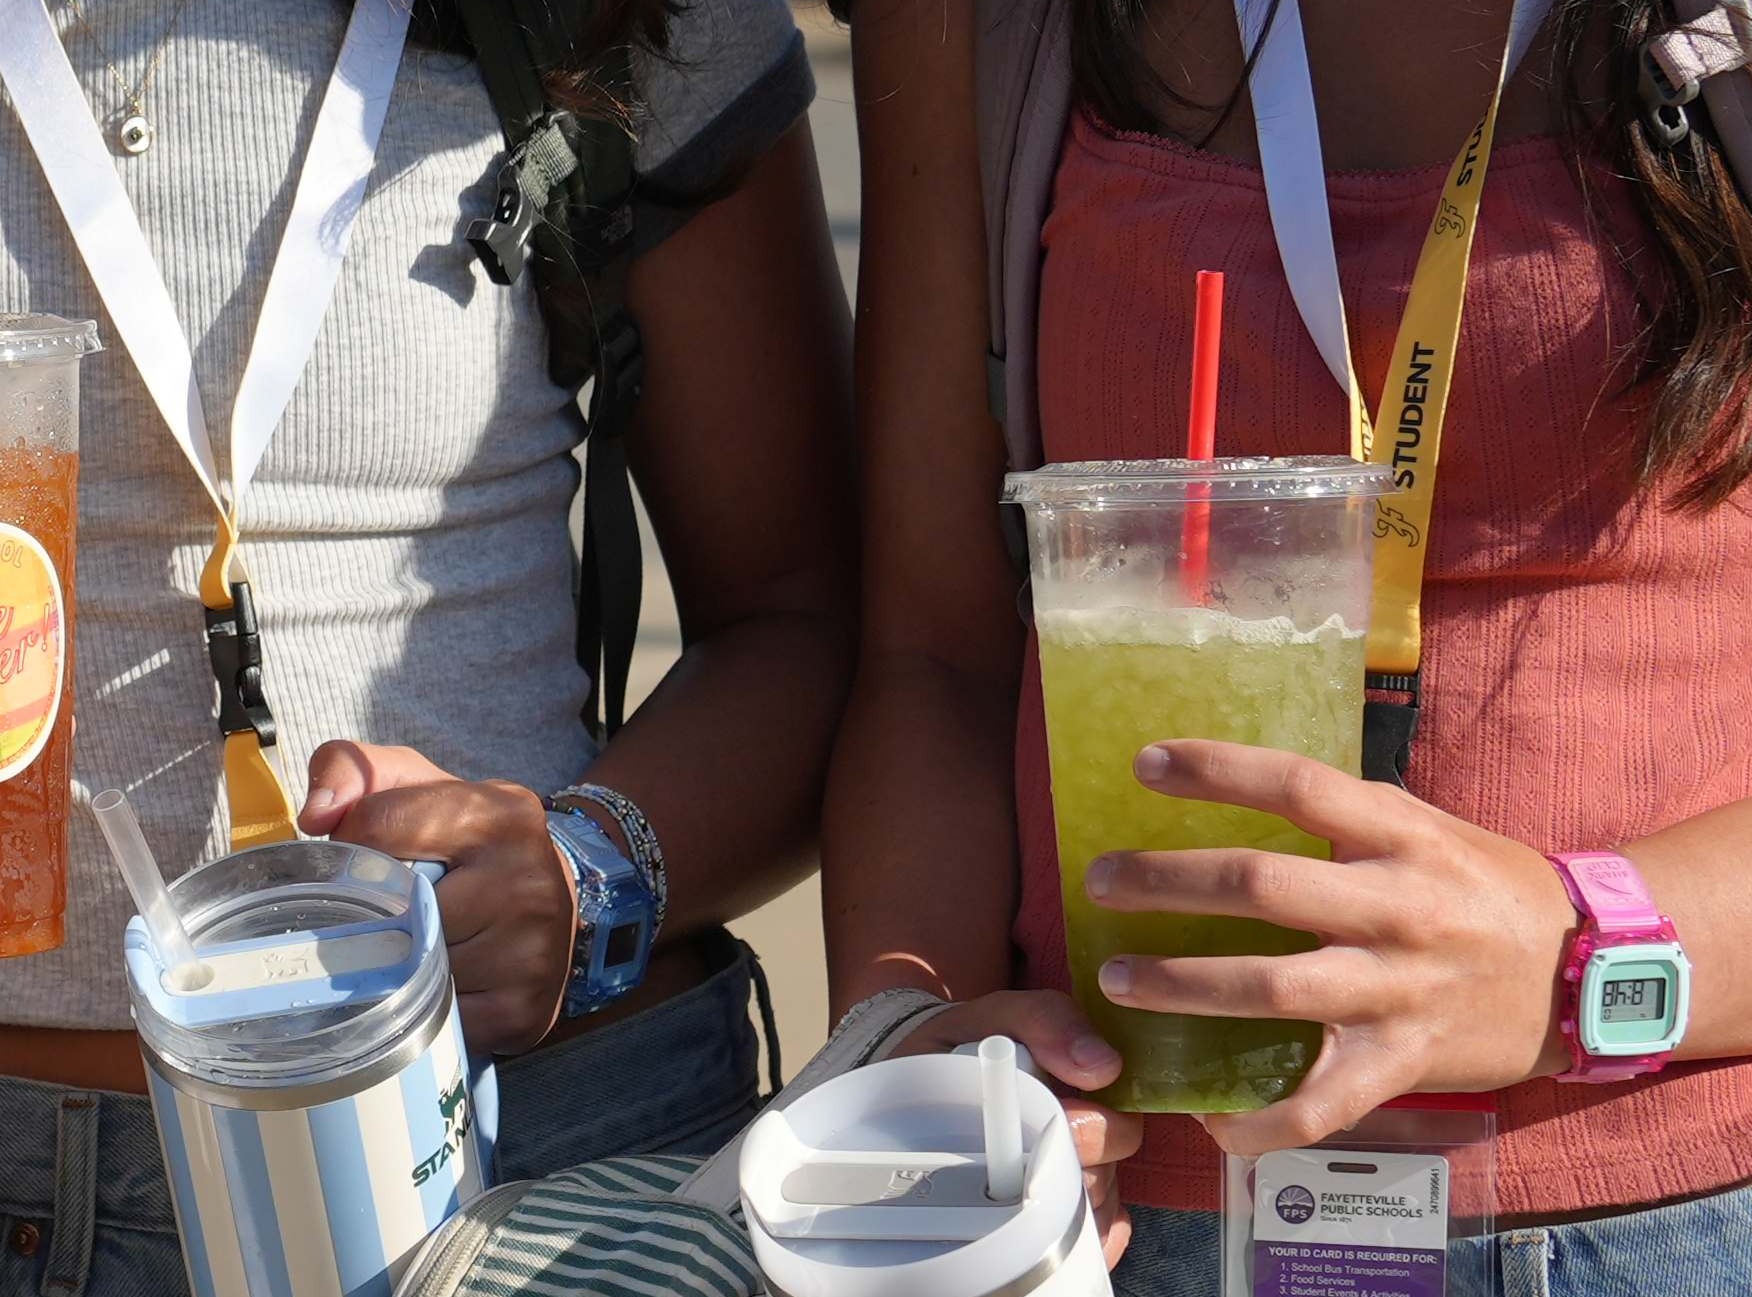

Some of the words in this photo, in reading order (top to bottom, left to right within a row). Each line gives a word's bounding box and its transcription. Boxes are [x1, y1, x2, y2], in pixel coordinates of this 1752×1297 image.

[1392, 340, 1436, 490] STUDENT
[1320, 1192, 1407, 1206] FAYETTEVILLE
[1283, 1208, 1308, 1219] FPS
[1320, 1204, 1364, 1216] PUBLIC
[1366, 1206, 1423, 1218] SCHOOLS
[1268, 1246, 1298, 1257] YOUR
[1300, 1248, 1311, 1258] ID
[1313, 1249, 1343, 1259] CARD
[1345, 1250, 1354, 1260] IS
[1357, 1251, 1410, 1263] REQUIRED
[1412, 1253, 1438, 1264] FOR:
[1280, 1262, 1289, 1271] 1.
[1291, 1263, 1323, 1273] School
[1325, 1264, 1342, 1274] Bus
[1344, 1265, 1410, 1277] Transportation
[1279, 1274, 1288, 1283] 2.
[1291, 1275, 1315, 1285] Food
[1316, 1276, 1355, 1286] Services
[1279, 1286, 1288, 1295] 3.
[1291, 1287, 1325, 1297] Student
[1328, 1288, 1358, 1297] Events
[1361, 1289, 1368, 1297] &
[1370, 1289, 1410, 1297] Activities
